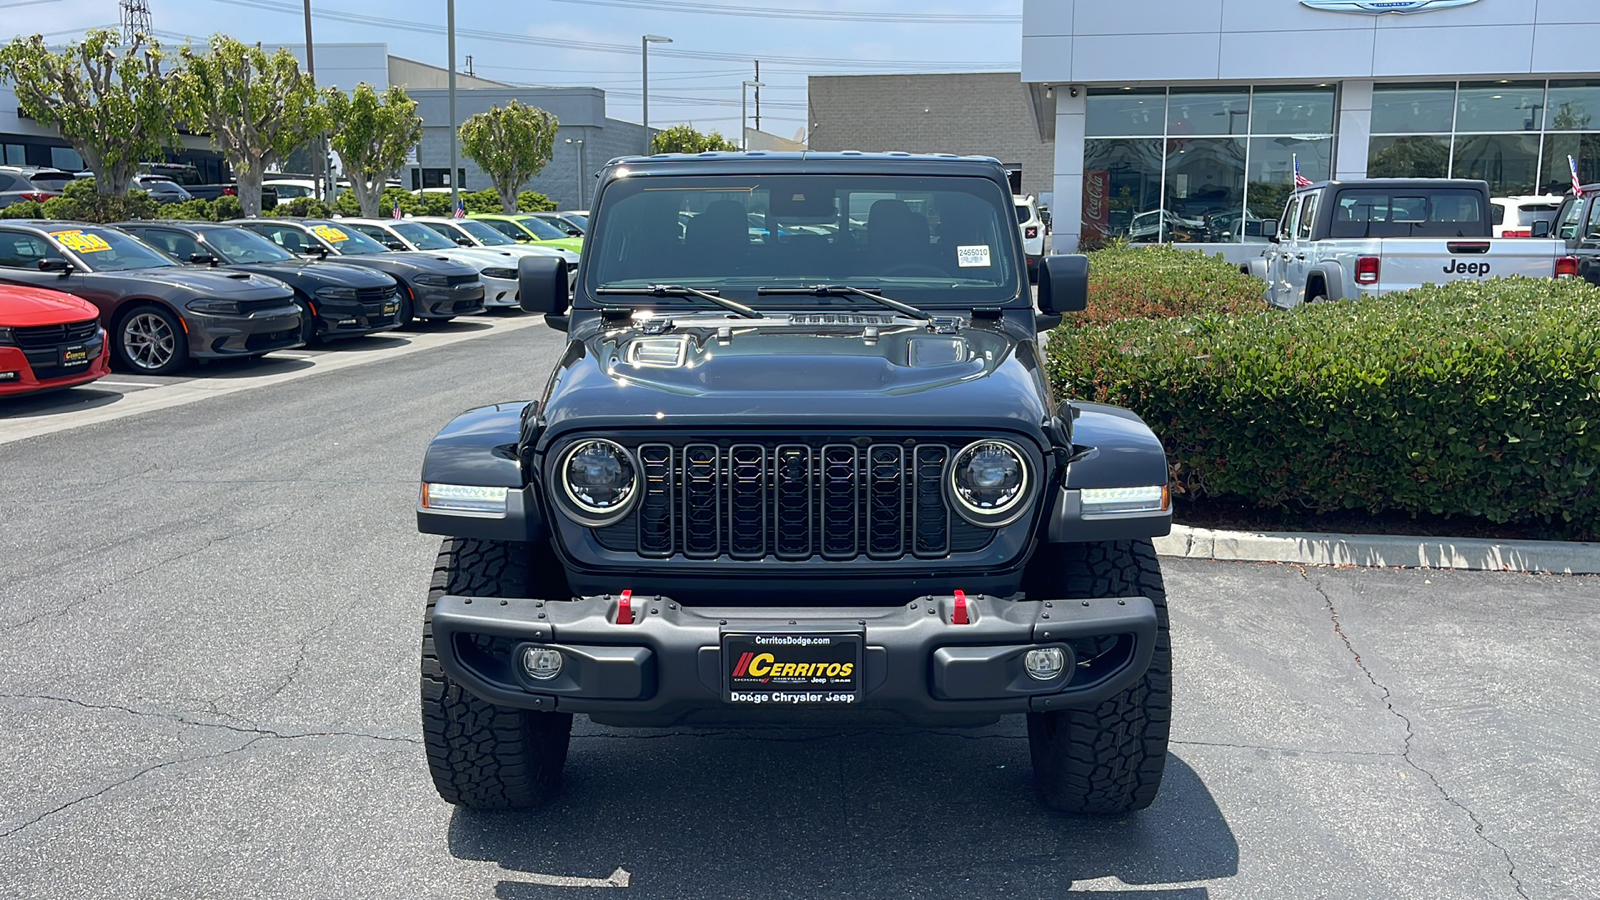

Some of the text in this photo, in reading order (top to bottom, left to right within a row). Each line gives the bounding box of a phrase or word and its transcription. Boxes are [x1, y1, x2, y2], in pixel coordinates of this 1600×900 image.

[959, 248, 988, 257] 2465010
[1443, 259, 1491, 277] Jeep
[755, 636, 831, 646] CerritosDodge.com
[748, 652, 854, 677] CERRITOS
[731, 692, 855, 704] Dodge Chrysler Jeep
